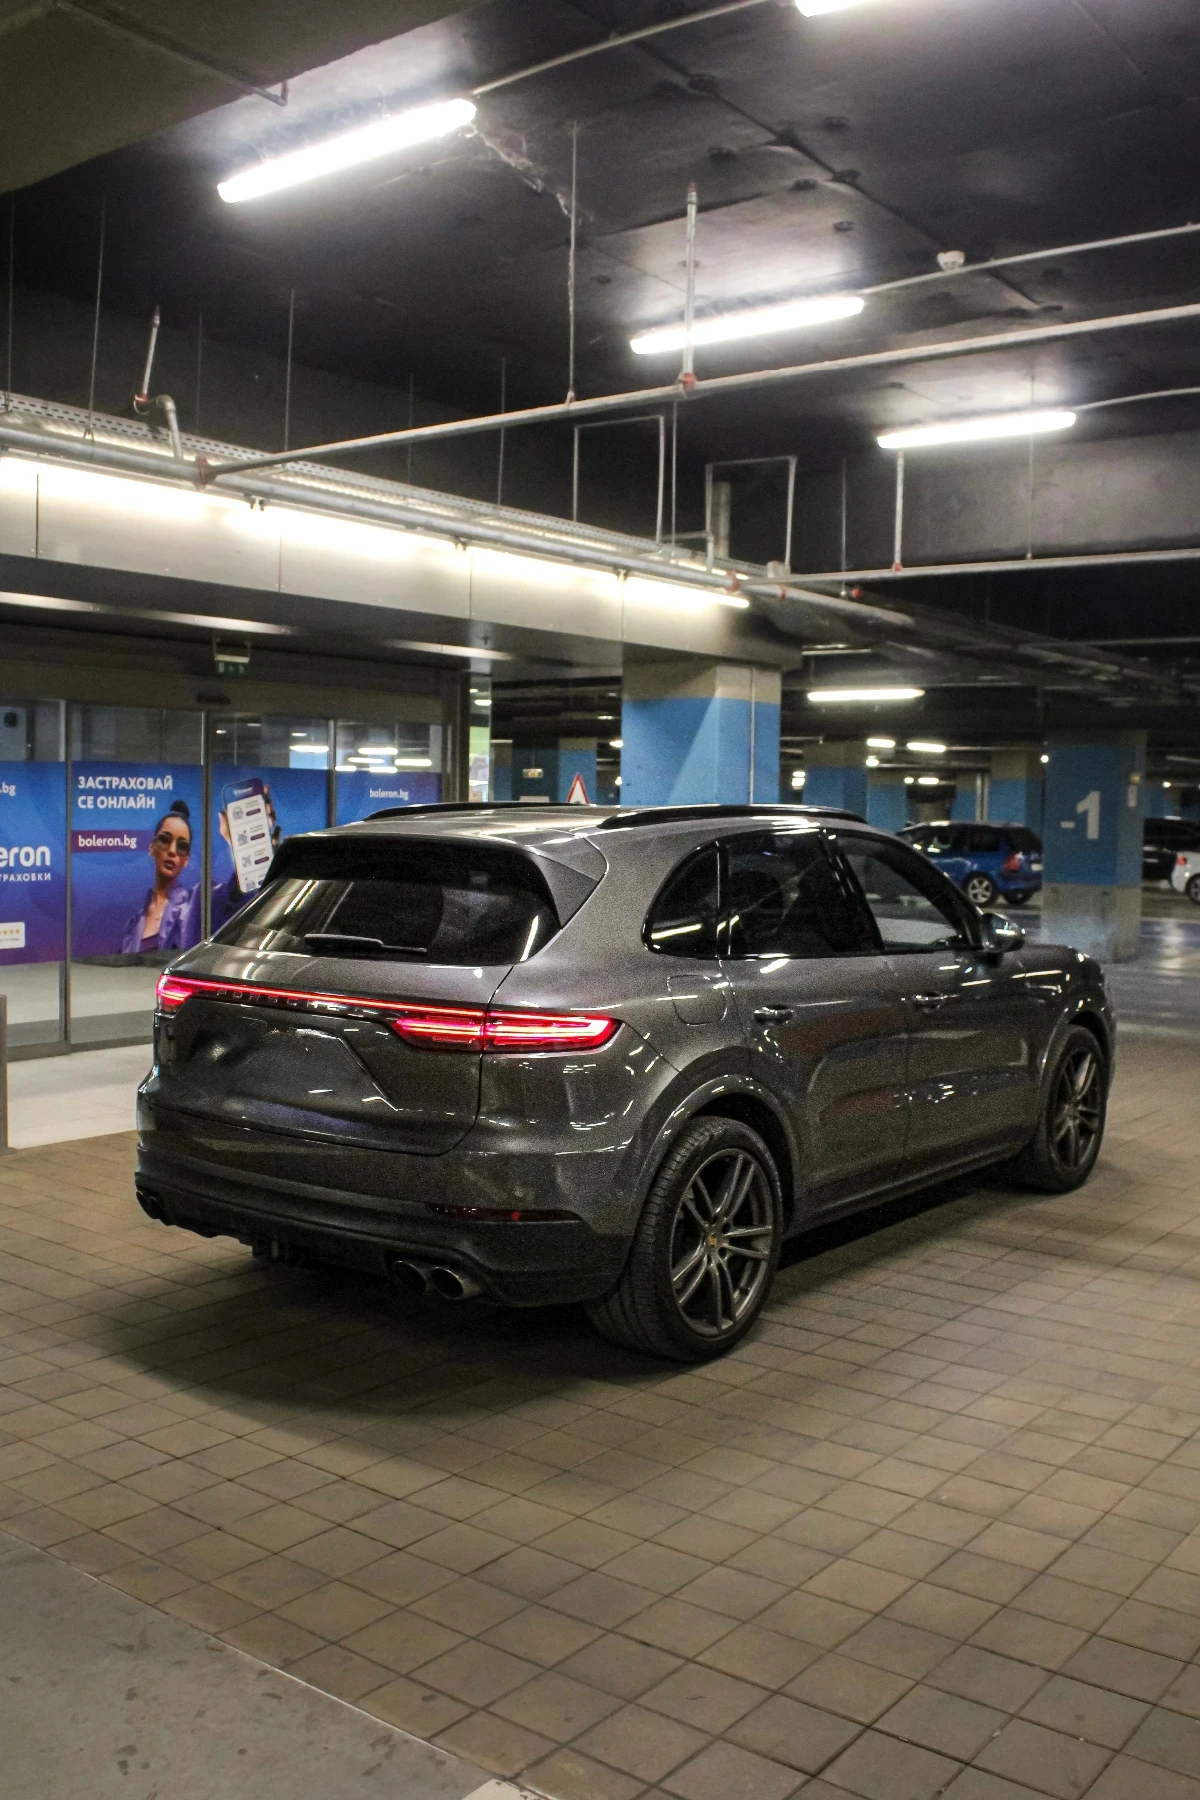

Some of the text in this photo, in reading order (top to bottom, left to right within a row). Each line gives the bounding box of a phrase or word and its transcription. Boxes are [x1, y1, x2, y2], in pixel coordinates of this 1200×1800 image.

[77, 775, 173, 790] ЗАСТРАХОВАЙ
[77, 794, 156, 809] СЕ ОНЛАЙН
[369, 787, 409, 801] boleron.bg
[1060, 790, 1101, 840] -1
[78, 835, 137, 849] boleron.bg
